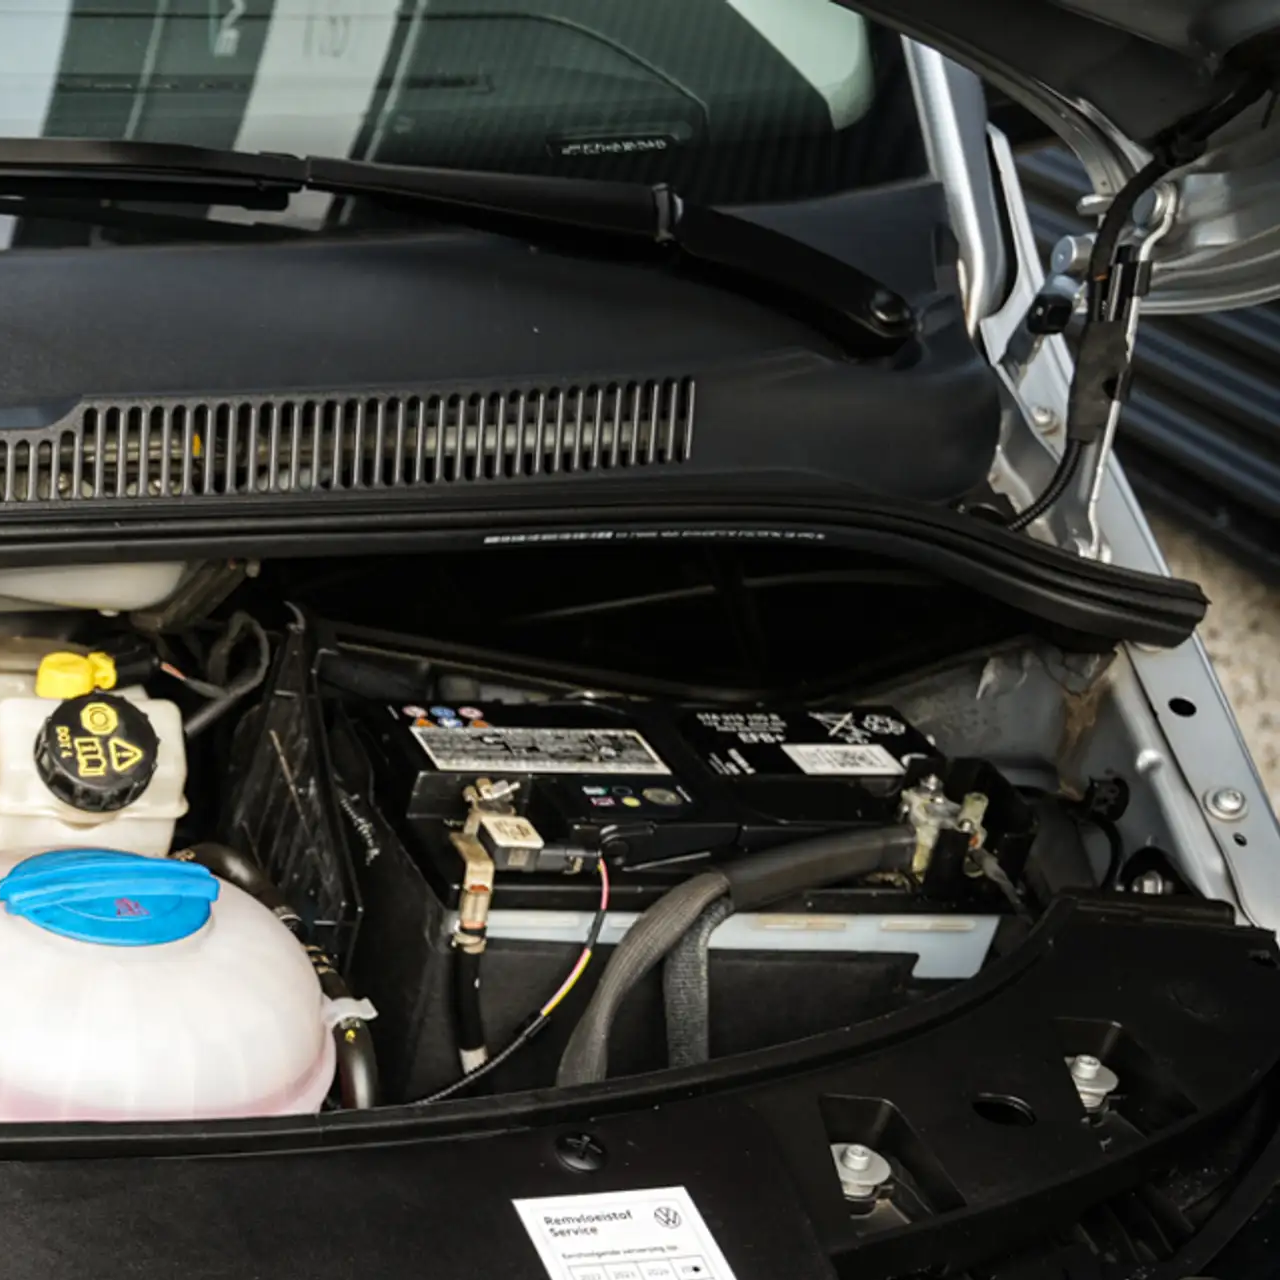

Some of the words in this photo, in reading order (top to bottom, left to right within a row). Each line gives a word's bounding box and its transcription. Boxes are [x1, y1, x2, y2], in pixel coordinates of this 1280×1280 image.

[57, 727, 72, 748] DOT
[61, 749, 73, 758] 4
[544, 1210, 633, 1226] Remvloeistof
[549, 1226, 598, 1238] Service
